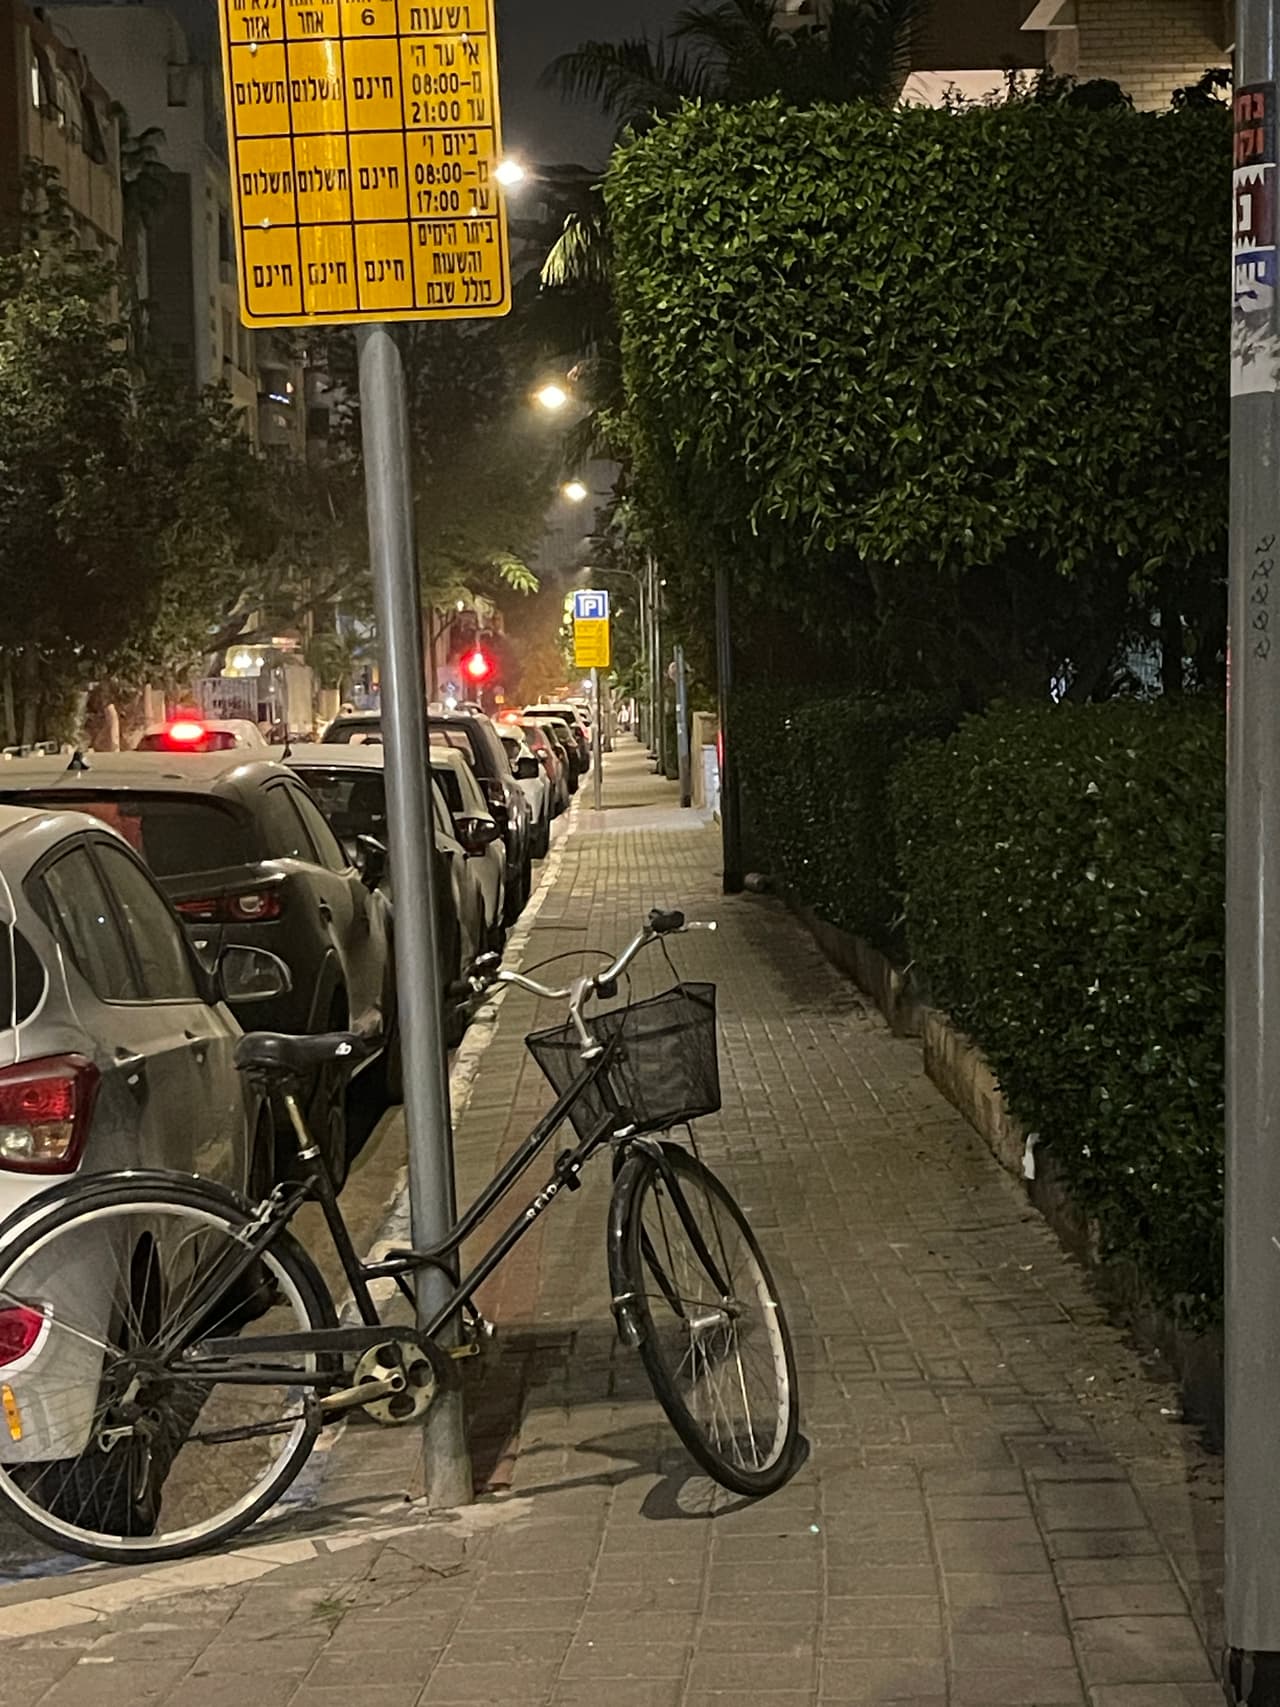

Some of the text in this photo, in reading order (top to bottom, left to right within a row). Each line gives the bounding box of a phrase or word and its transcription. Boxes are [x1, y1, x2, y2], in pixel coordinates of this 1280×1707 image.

[242, 16, 269, 38] אזור
[298, 12, 323, 33] אחר
[361, 9, 374, 25] 6
[410, 6, 469, 30] ושעות
[434, 44, 454, 66] עד
[236, 79, 284, 105] תשלום
[353, 77, 393, 100] חינם
[412, 99, 484, 123] עד 21:00
[442, 133, 477, 156] ביום
[242, 169, 291, 195] תשלום
[298, 163, 348, 192] תשלום
[359, 167, 398, 190] חינם
[417, 188, 488, 212] עד 17:00
[418, 221, 493, 246] ביתר הימים
[365, 259, 404, 282] חינם
[433, 251, 481, 274] והשעות
[253, 264, 292, 288] חינם
[427, 277, 492, 305] כולל שבת
[585, 600, 597, 617] P
